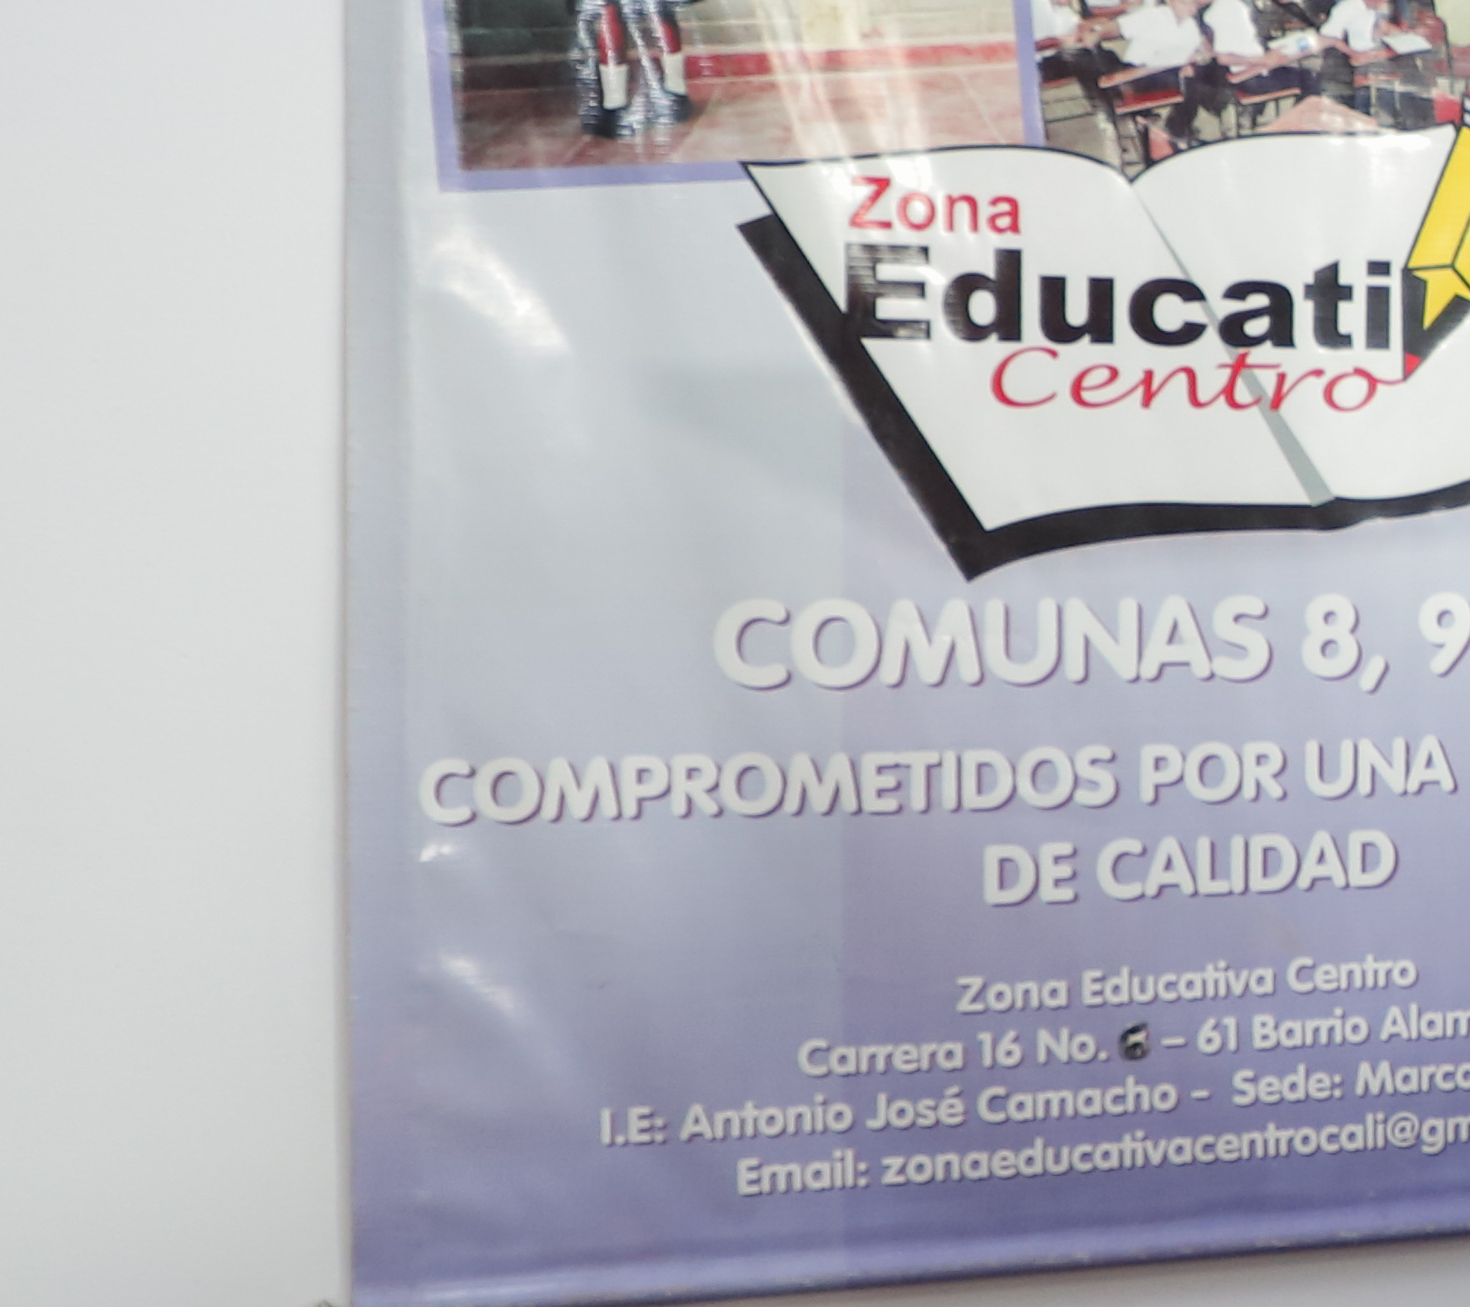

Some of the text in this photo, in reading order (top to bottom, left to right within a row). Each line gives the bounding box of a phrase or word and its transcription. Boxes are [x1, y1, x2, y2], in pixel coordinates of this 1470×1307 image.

[847, 176, 1023, 235] Zona
[988, 346, 1402, 412] Centro
[713, 594, 1273, 691] COMUNAS
[1302, 592, 1388, 693] 8,
[418, 744, 1120, 827] COMPROMETIDOS
[1140, 740, 1288, 805] POR
[1304, 734, 1457, 800] UNA
[983, 828, 1399, 907] DE CALIDAD
[956, 951, 1419, 1015] Zona Educativa Centro
[797, 1037, 967, 1080] Carrera
[976, 1029, 1025, 1071] 16
[1036, 1026, 1111, 1068] No.
[1196, 1016, 1241, 1058] 61
[1251, 1010, 1372, 1053] Barrio
[599, 1104, 668, 1149] I.E:
[680, 1092, 856, 1144] Antonio
[865, 1083, 968, 1134] José
[976, 1071, 1181, 1126] Camacho
[1232, 1067, 1346, 1109] Sede:
[736, 1150, 871, 1200] Email:
